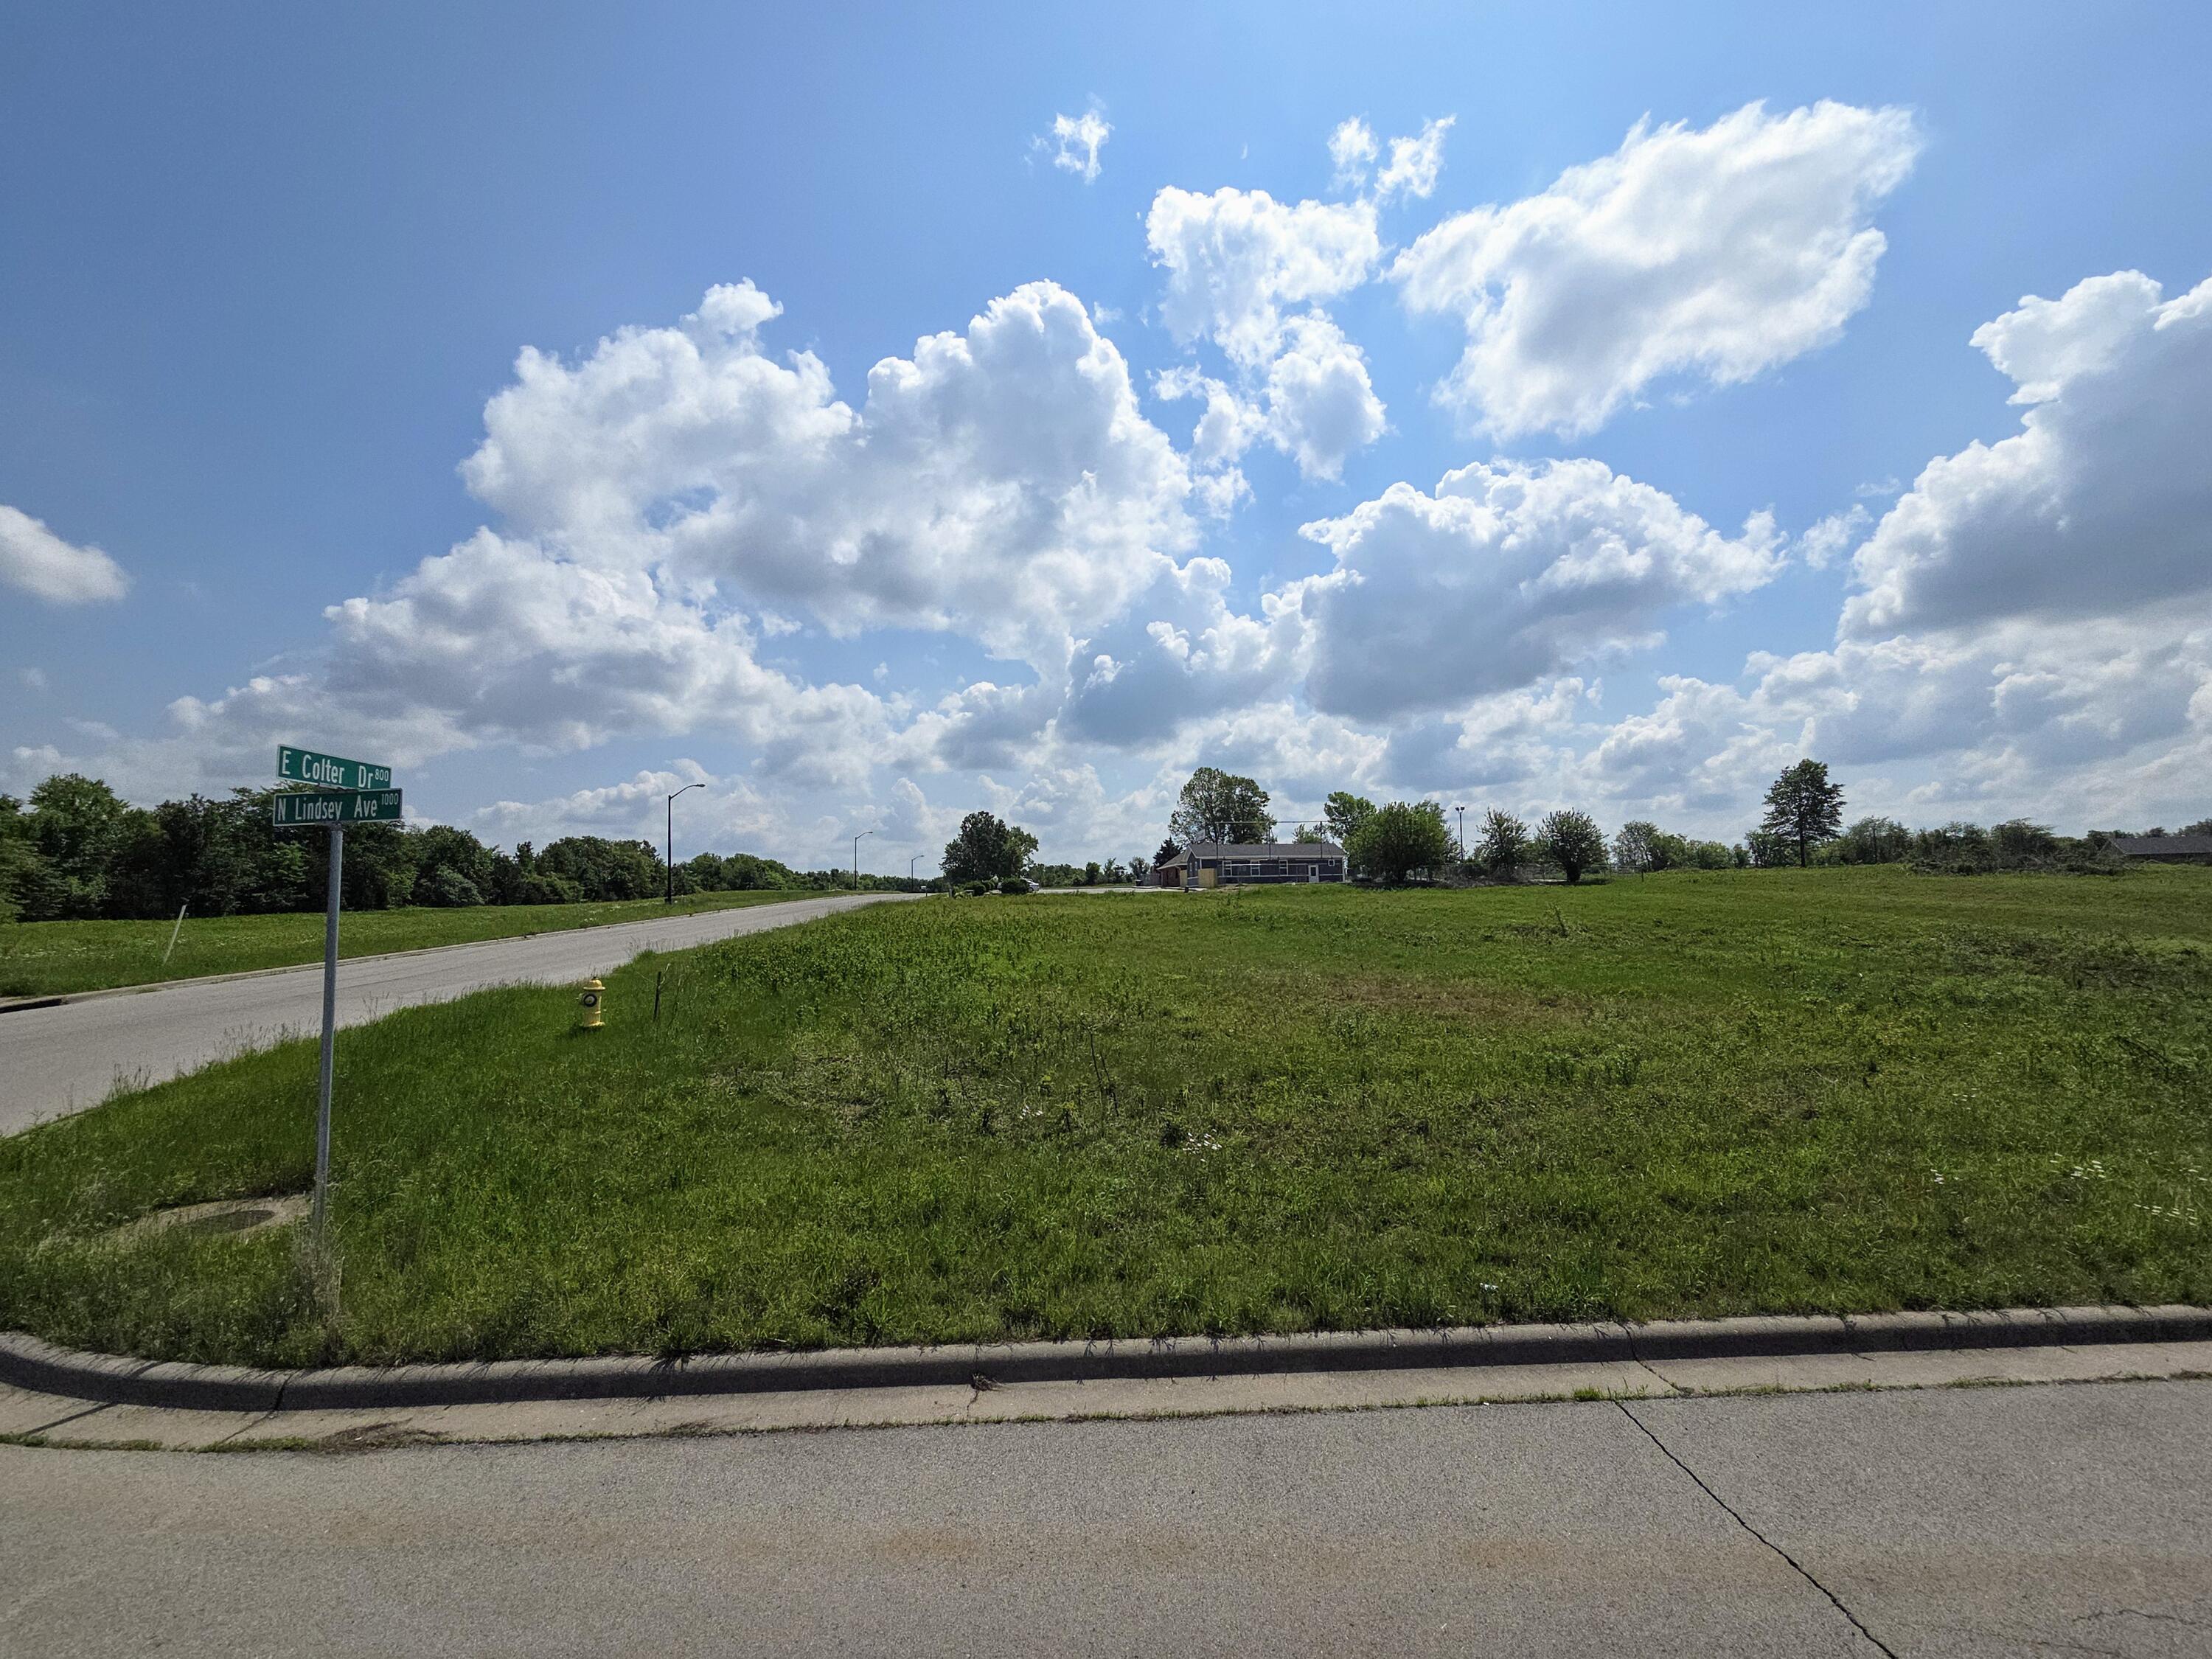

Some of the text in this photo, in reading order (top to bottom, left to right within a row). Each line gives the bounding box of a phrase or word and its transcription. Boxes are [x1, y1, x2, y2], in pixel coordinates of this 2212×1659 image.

[282, 751, 389, 788] E Colter Dr 800
[278, 793, 399, 821] N Lindsey Ave 1000
